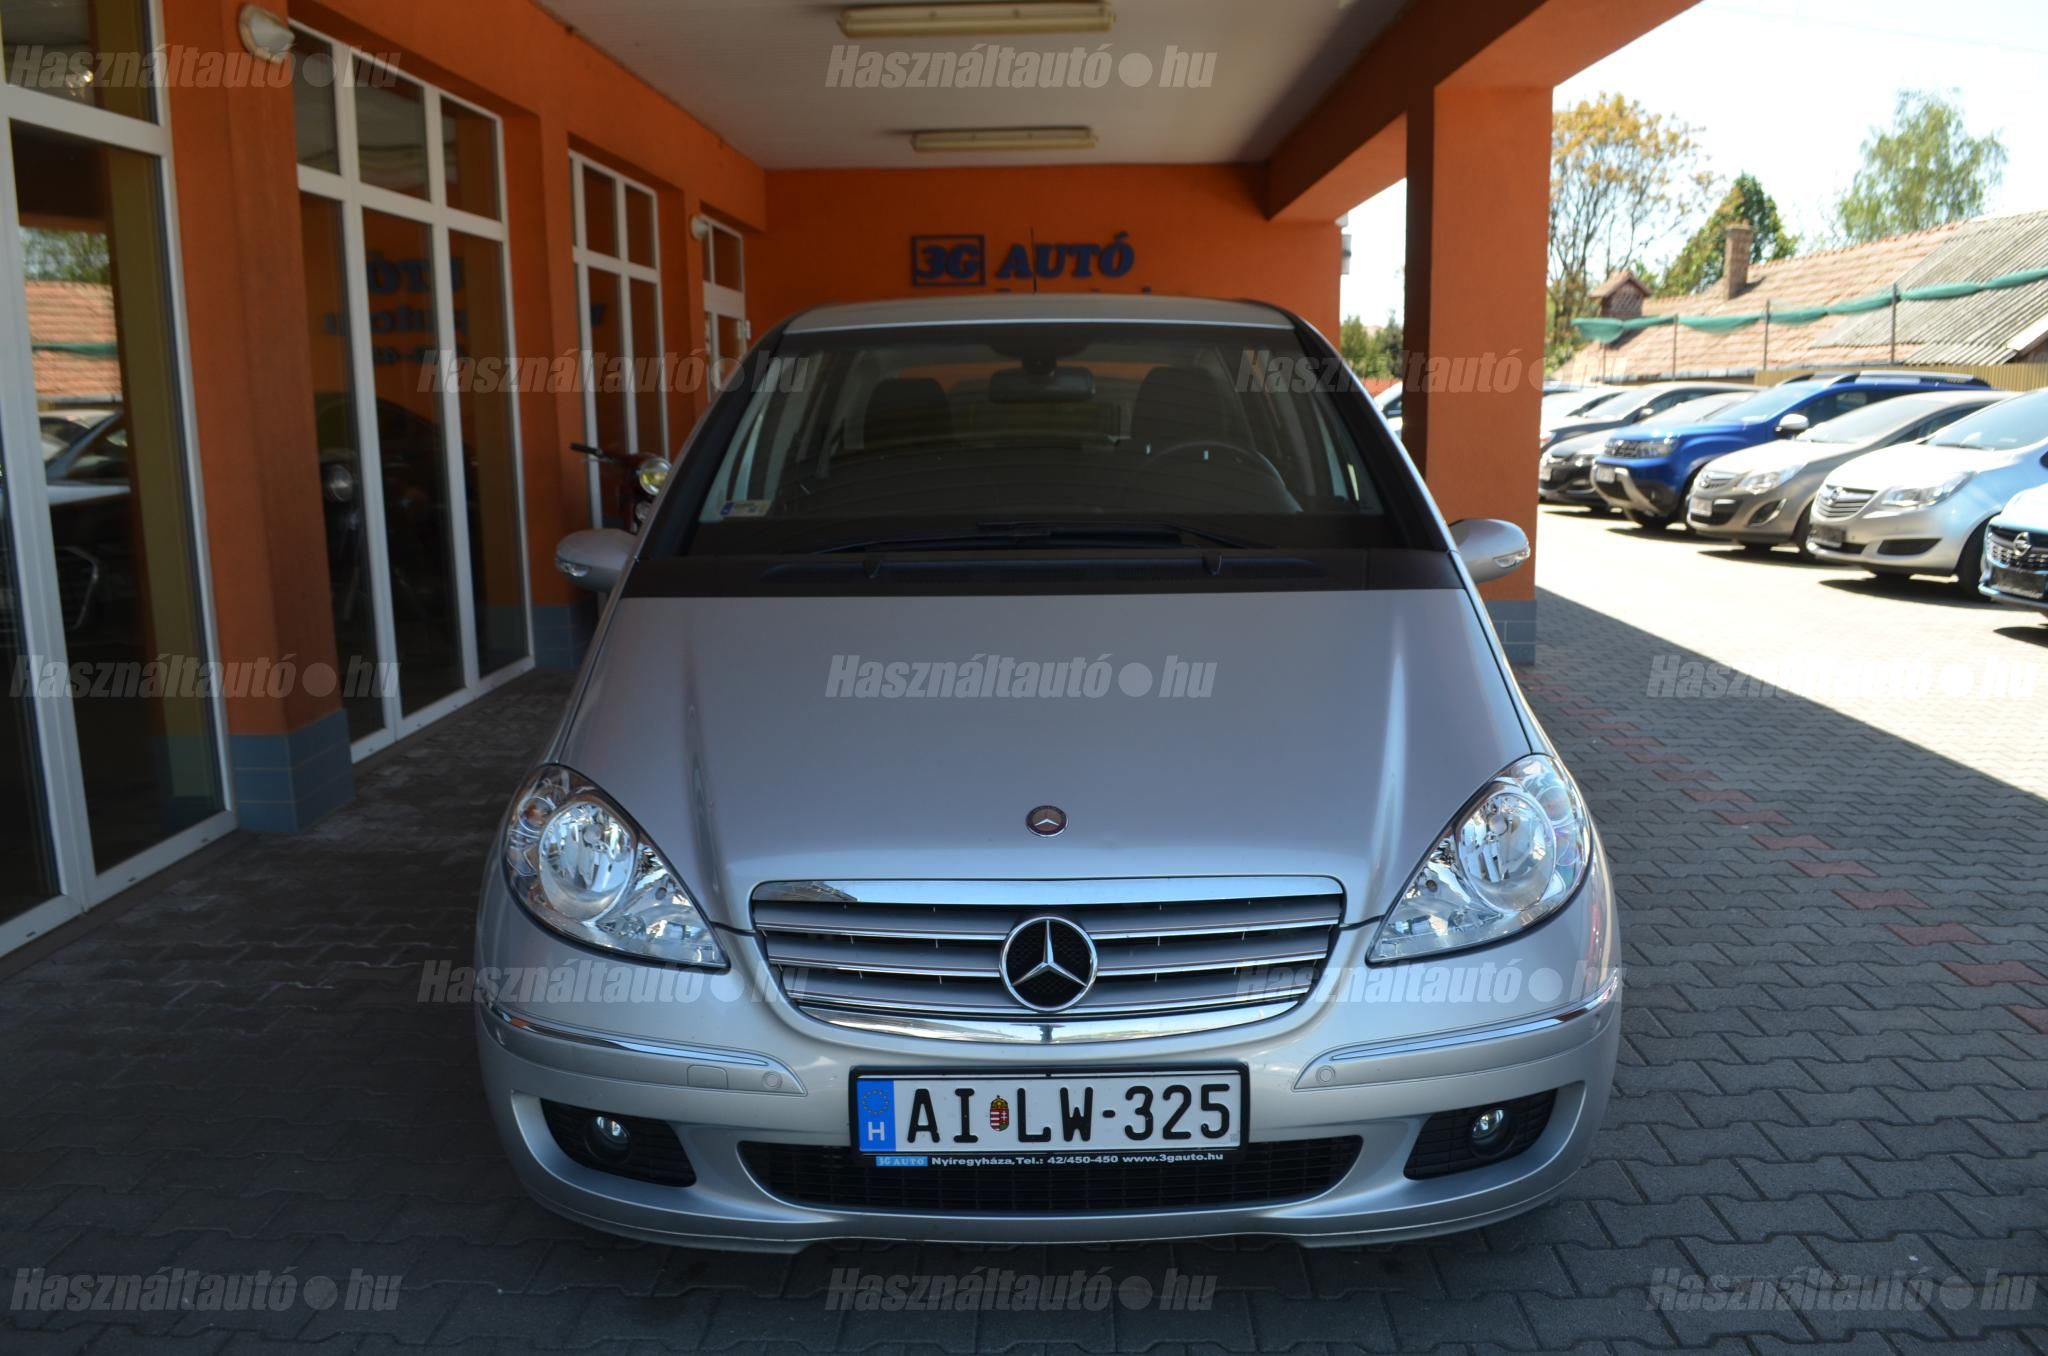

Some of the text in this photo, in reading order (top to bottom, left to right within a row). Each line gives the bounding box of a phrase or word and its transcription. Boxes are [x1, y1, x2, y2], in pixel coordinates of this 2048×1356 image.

[914, 231, 1136, 279] 3G AUTÓ
[867, 1121, 885, 1142] H
[1047, 1155, 1119, 1165] 42/450-450
[1122, 1152, 1224, 1164] www.3gauto.hu
